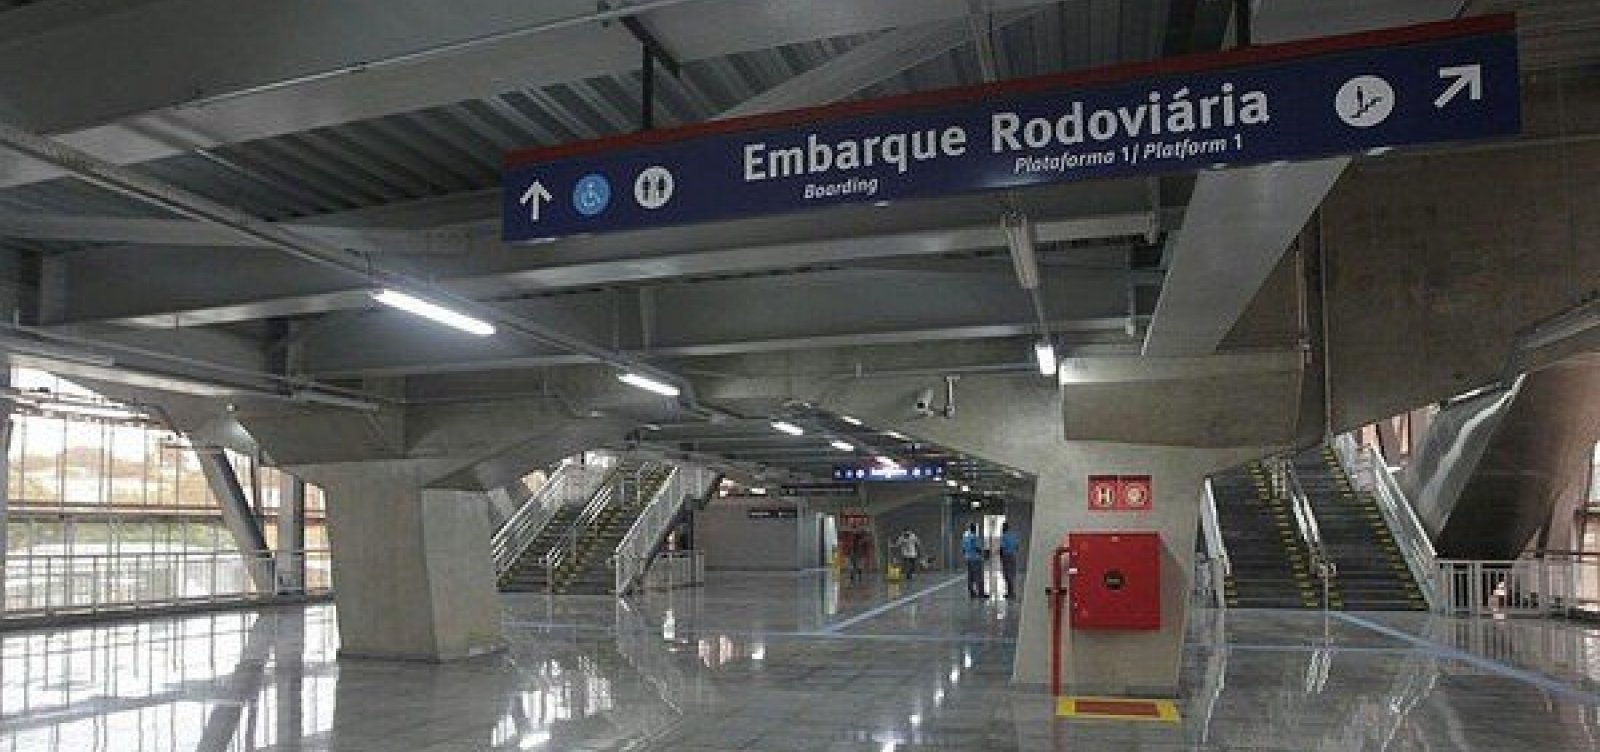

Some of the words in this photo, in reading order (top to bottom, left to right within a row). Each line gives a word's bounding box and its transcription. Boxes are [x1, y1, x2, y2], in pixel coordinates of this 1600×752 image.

[743, 128, 966, 182] Embarque
[991, 83, 1270, 153] Rodoviária
[1013, 152, 1116, 175] Plataforma
[1143, 138, 1228, 160] Platform
[1234, 133, 1242, 151] 1
[803, 178, 879, 200] Boarding
[1098, 487, 1110, 503] H
